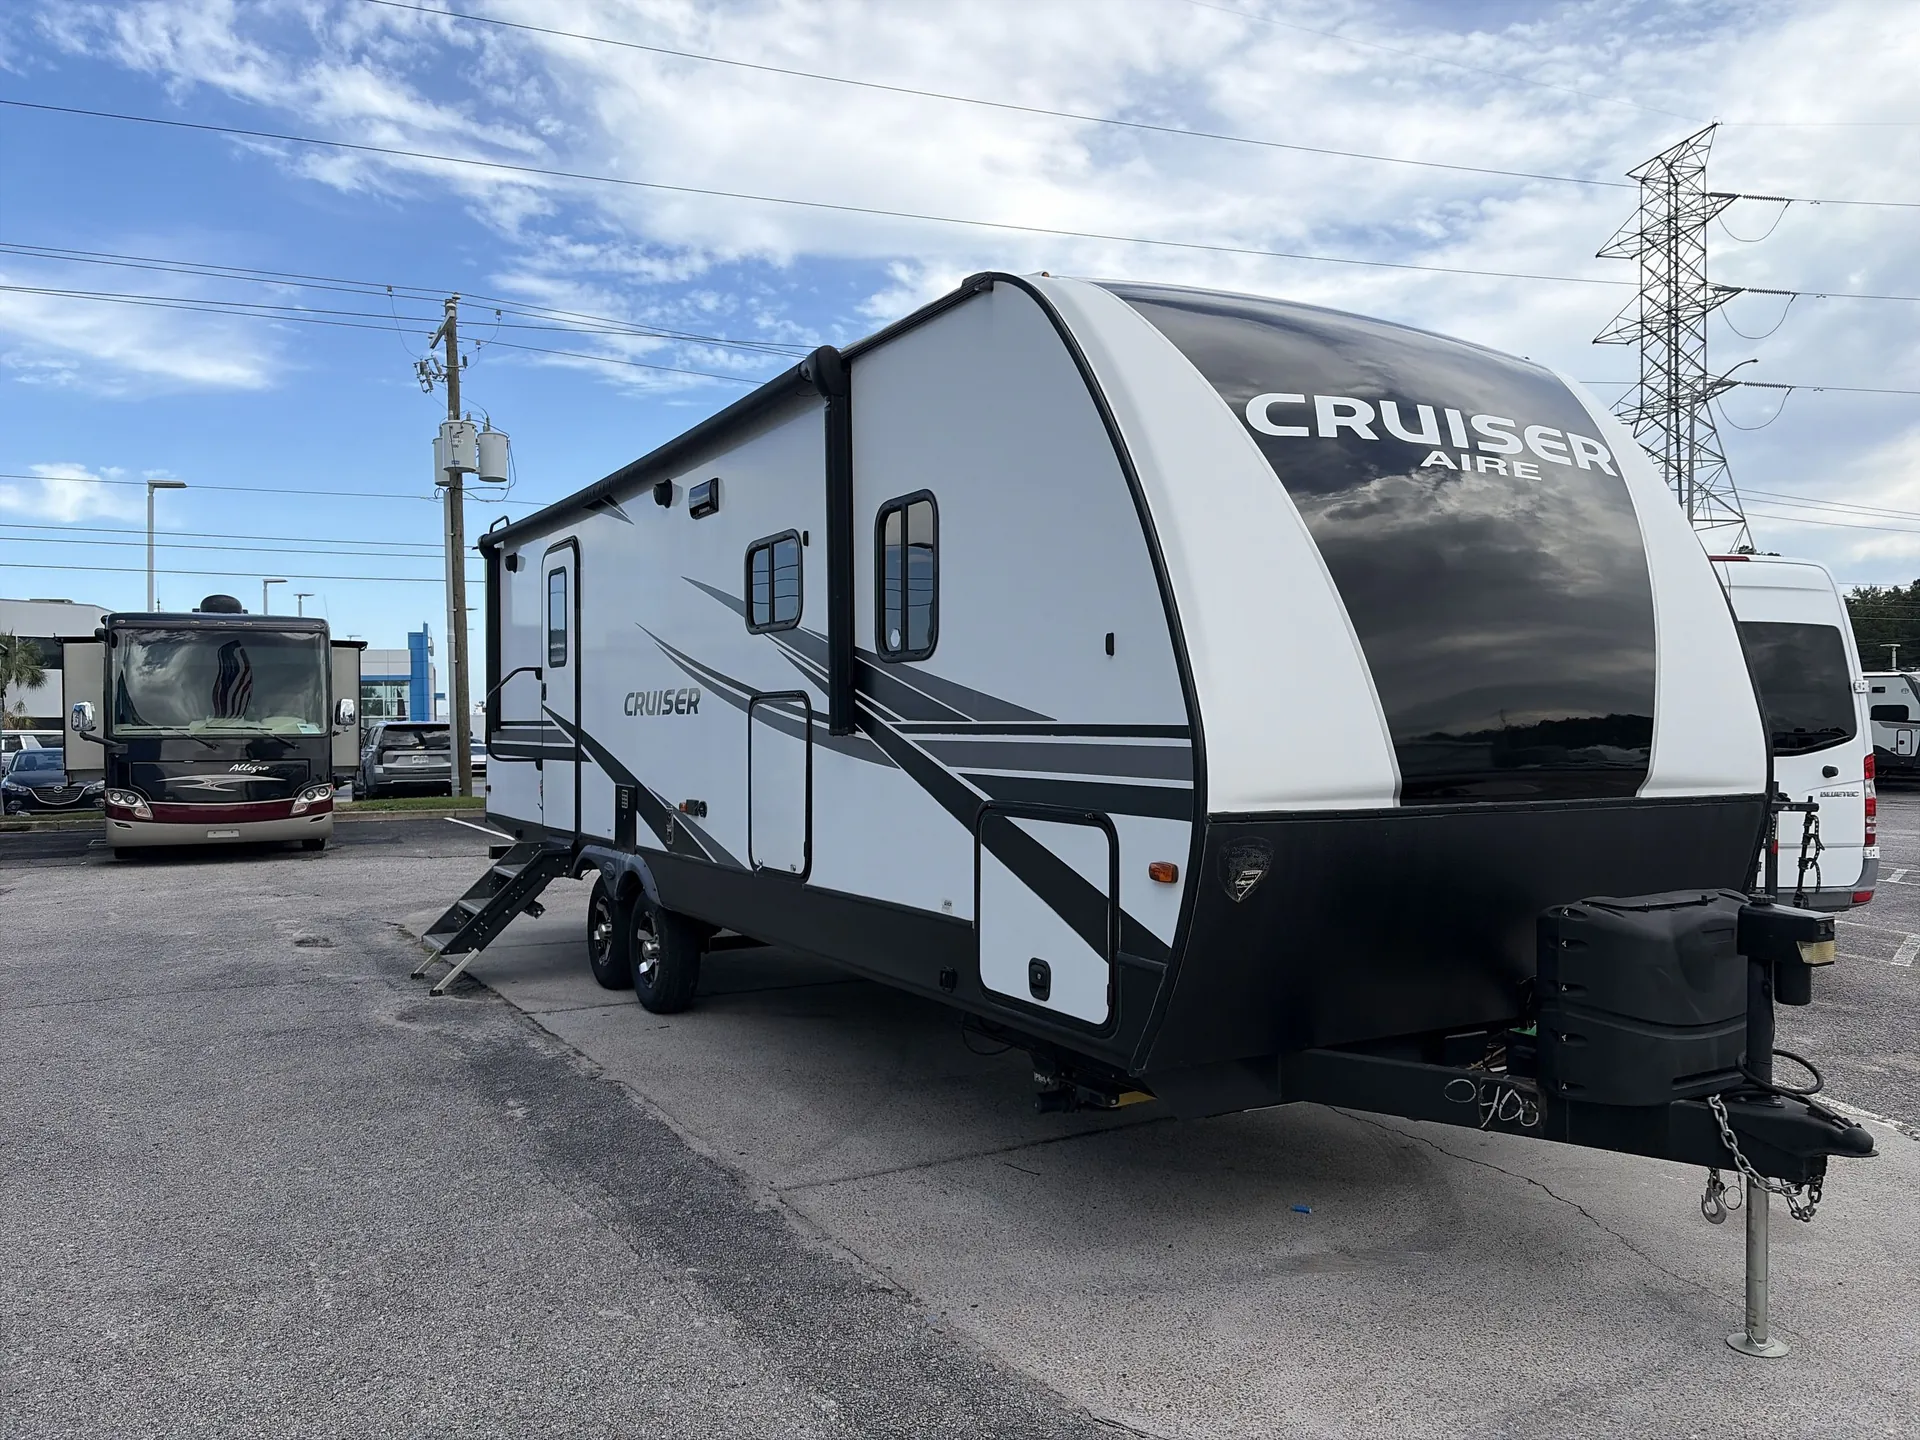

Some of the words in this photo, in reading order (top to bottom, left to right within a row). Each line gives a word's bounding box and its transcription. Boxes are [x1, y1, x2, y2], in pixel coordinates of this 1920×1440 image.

[1245, 392, 1618, 477] CRUISER
[1420, 450, 1542, 481] AIRE
[623, 687, 701, 717] CRUISER
[228, 763, 270, 774] Allegro
